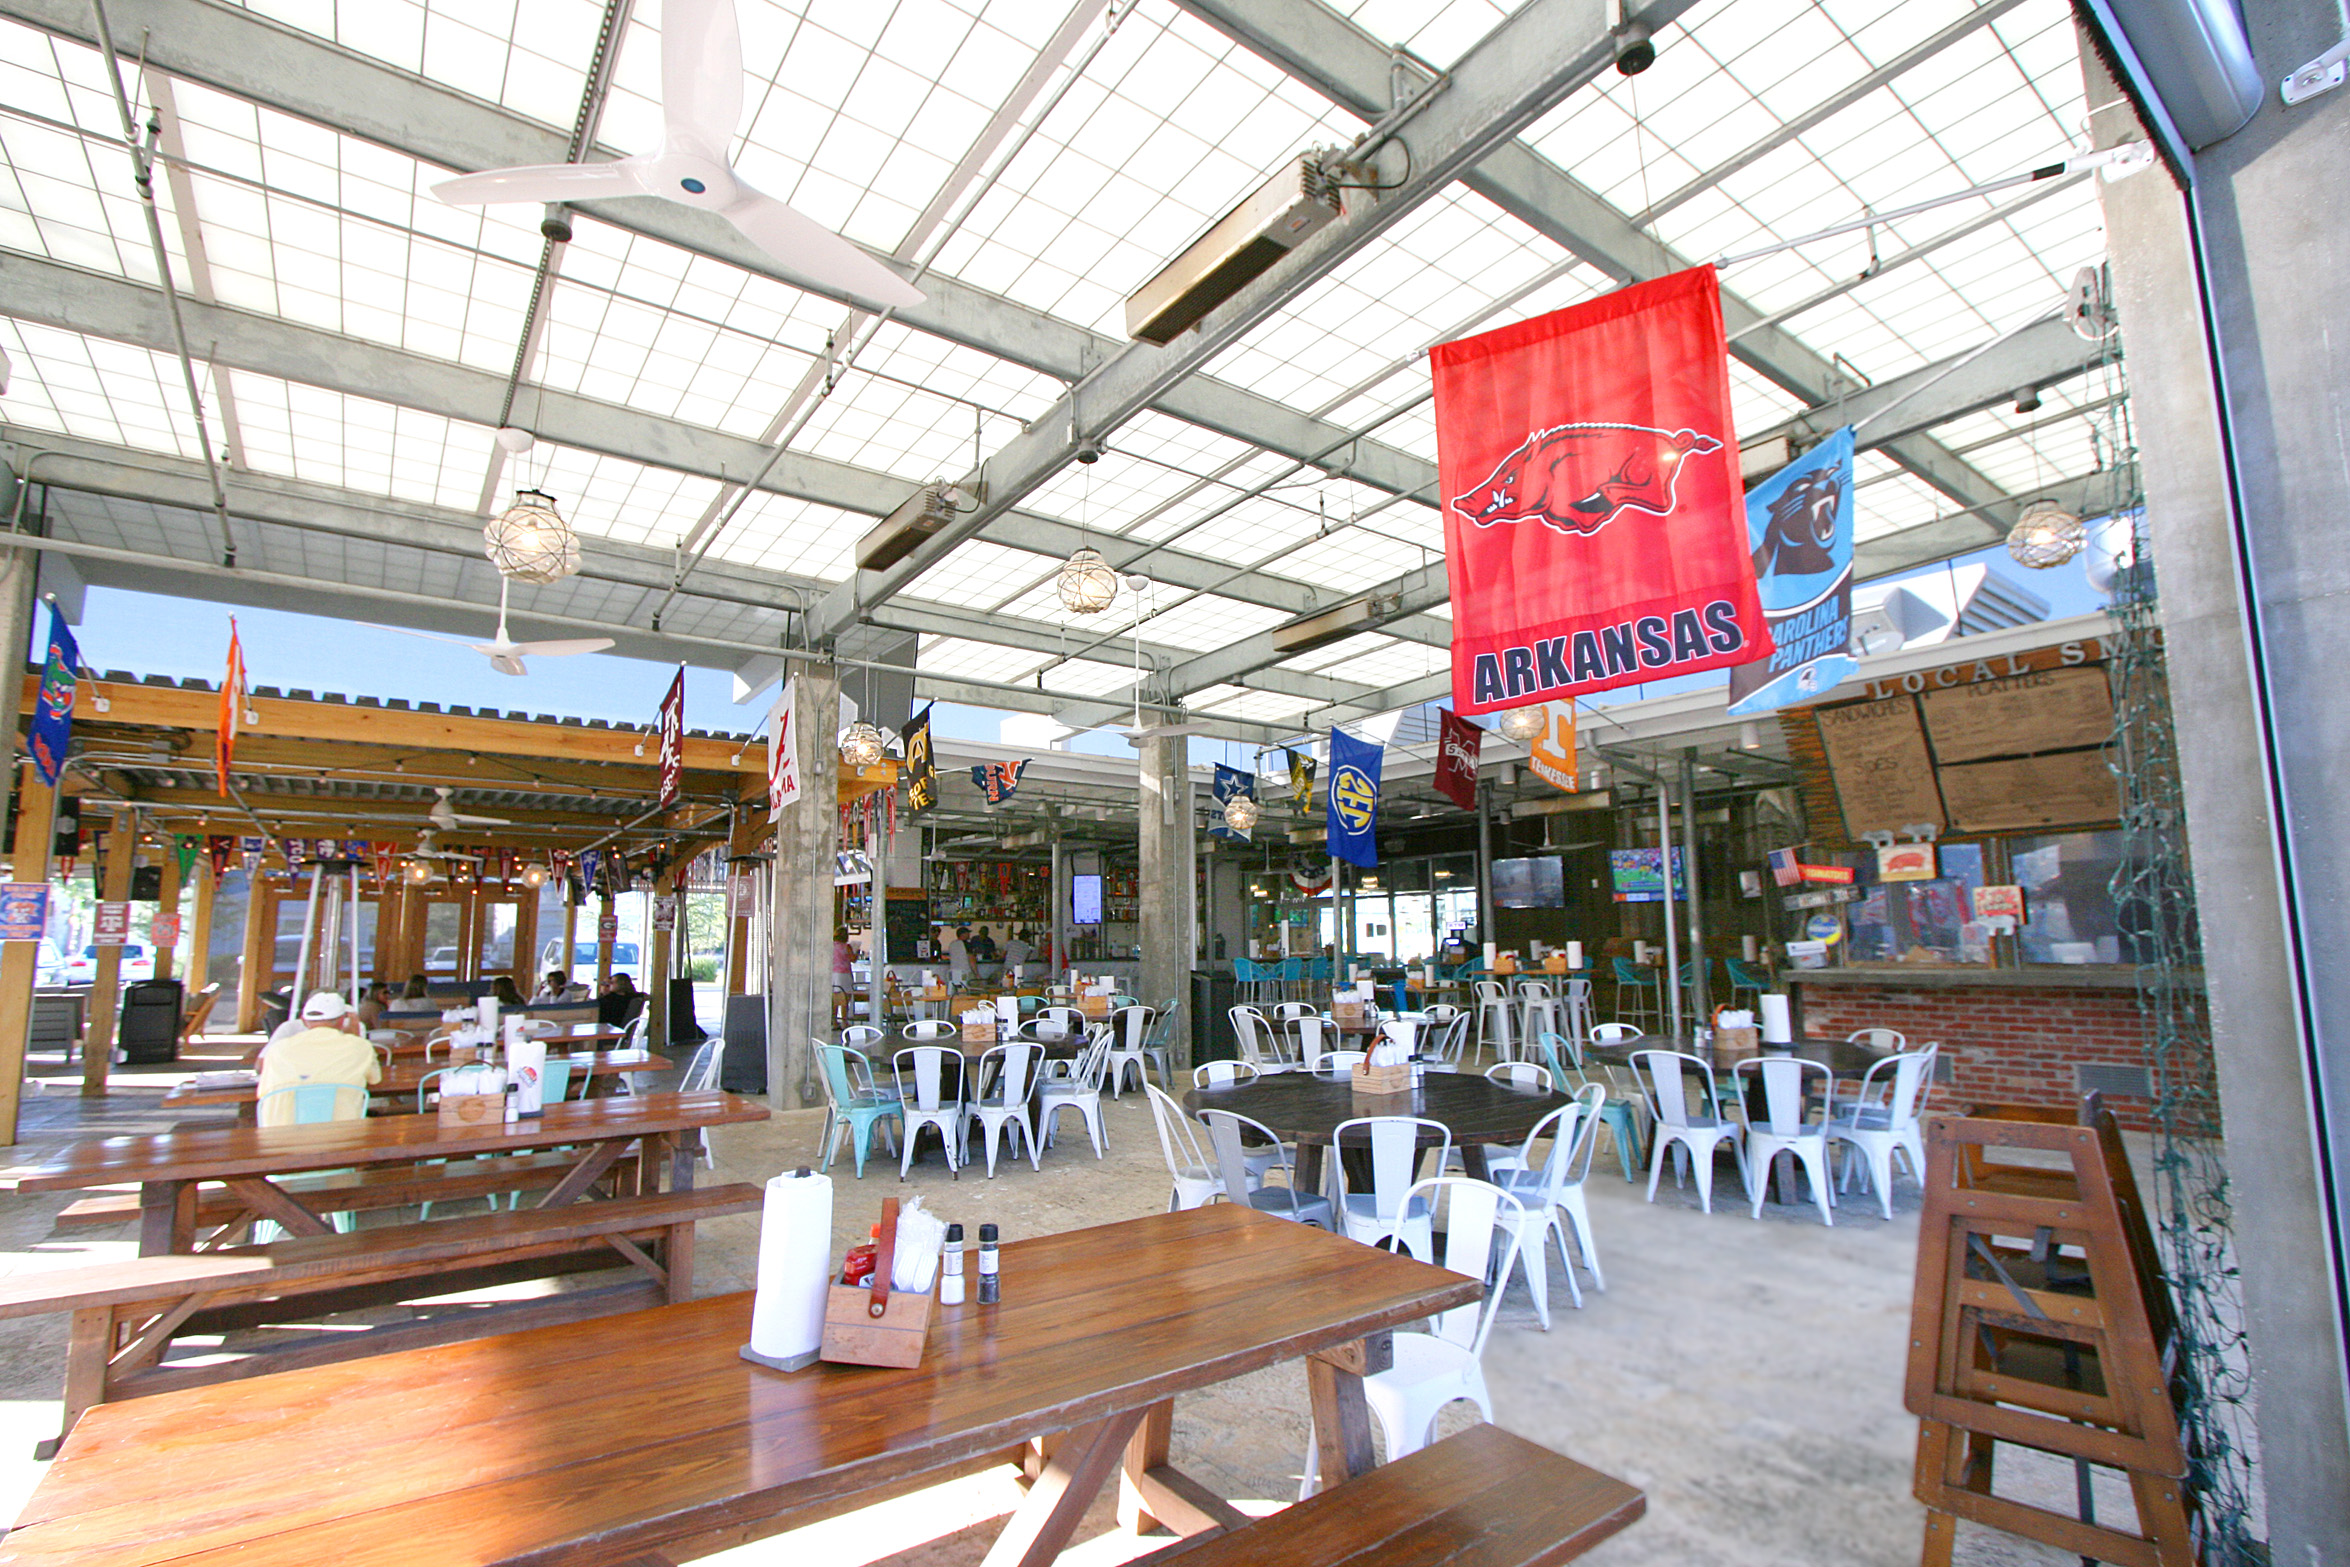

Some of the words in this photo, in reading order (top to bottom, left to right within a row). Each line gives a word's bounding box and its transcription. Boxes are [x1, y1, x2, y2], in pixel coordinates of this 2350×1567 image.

[1768, 596, 1840, 645] AROLINA
[1474, 600, 1744, 704] ARKANSAS
[1871, 655, 2030, 700] LOCAL
[985, 763, 1000, 803] BURN
